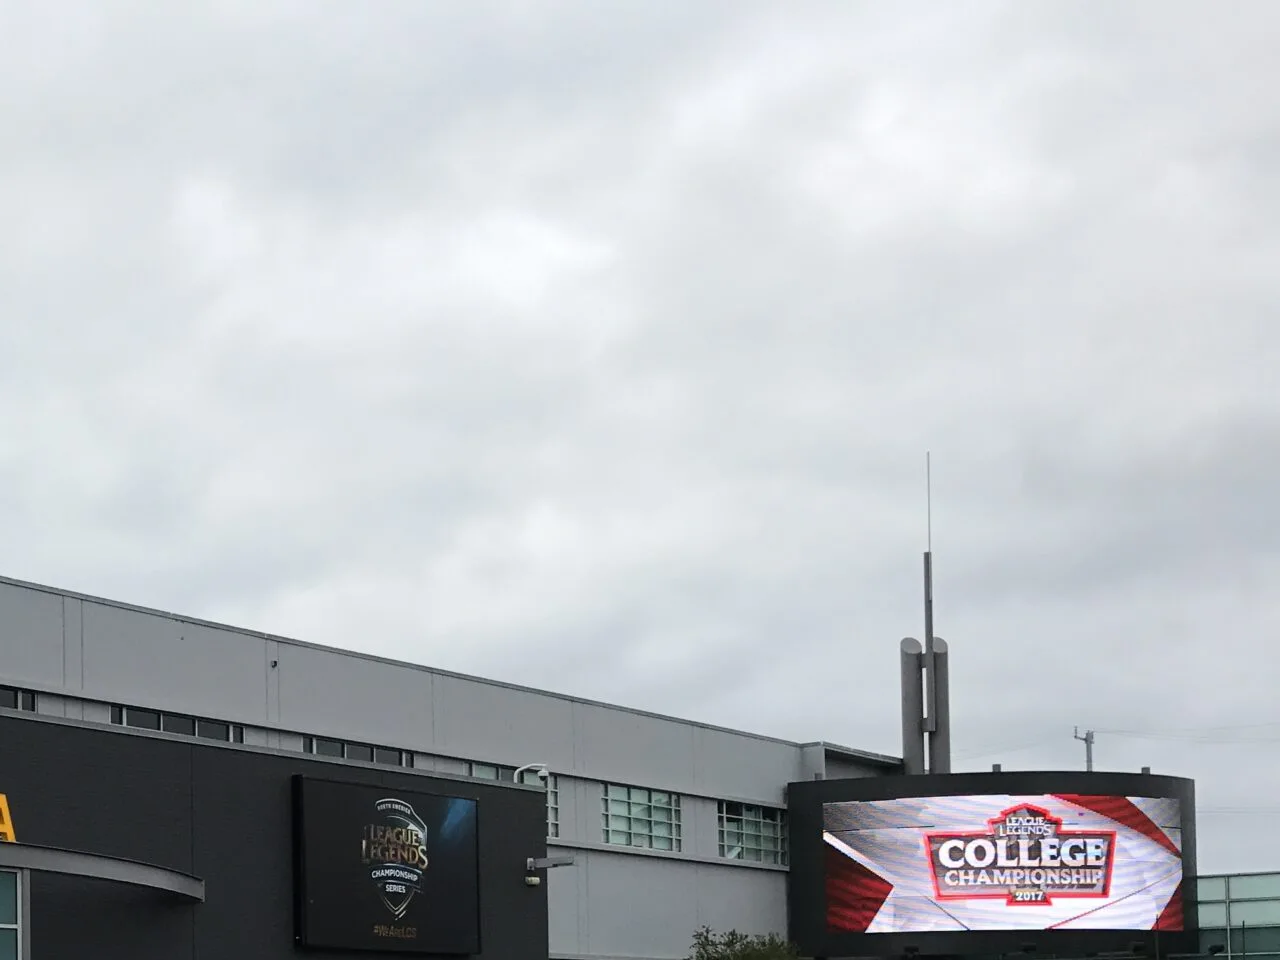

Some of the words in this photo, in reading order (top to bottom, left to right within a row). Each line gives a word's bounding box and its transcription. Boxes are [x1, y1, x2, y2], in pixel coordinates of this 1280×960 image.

[1006, 817, 1045, 826] LEAGUE
[370, 824, 419, 846] LEAGUE
[999, 825, 1052, 836] LEGENDS
[938, 839, 1106, 868] COLLEGE
[371, 869, 418, 881] CHAMPIONSHIP
[944, 868, 1104, 886] CHAMPIONSHIP
[385, 884, 406, 893] SERIES
[1016, 891, 1044, 901] 2017
